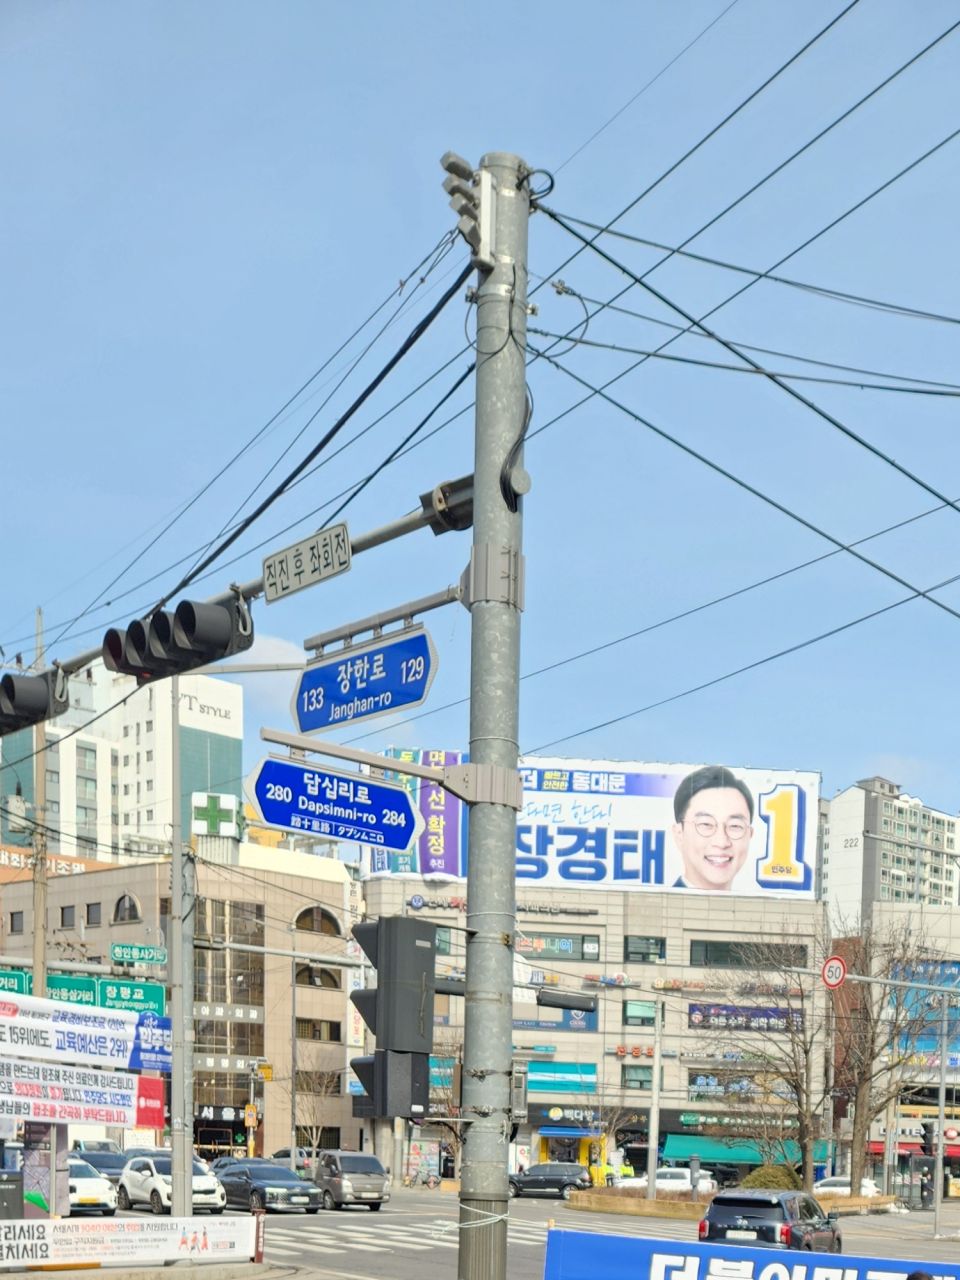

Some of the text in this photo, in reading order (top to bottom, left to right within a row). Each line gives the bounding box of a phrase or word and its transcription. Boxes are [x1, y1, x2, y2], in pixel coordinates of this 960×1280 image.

[266, 526, 348, 596] 직진 후 좌회전
[302, 653, 425, 713] 133 장한로 129
[199, 703, 232, 720] STYLE
[328, 691, 393, 722] Janghan-ro
[572, 772, 626, 793] 동대문
[265, 772, 407, 827] 280 답십리로 284
[298, 795, 377, 825] Dapsimni-ro
[519, 801, 566, 824] 다면
[428, 816, 446, 856] 확정
[757, 785, 810, 890] 1
[843, 837, 859, 849] 222
[429, 857, 445, 869] 추진
[516, 825, 666, 885] 장경태
[826, 964, 843, 982] 50
[55, 1030, 107, 1056] 교육예산은
[109, 1038, 128, 1058] 2위!
[83, 1107, 128, 1124] 부탁드립니다.
[0, 1224, 46, 1241] 리세요
